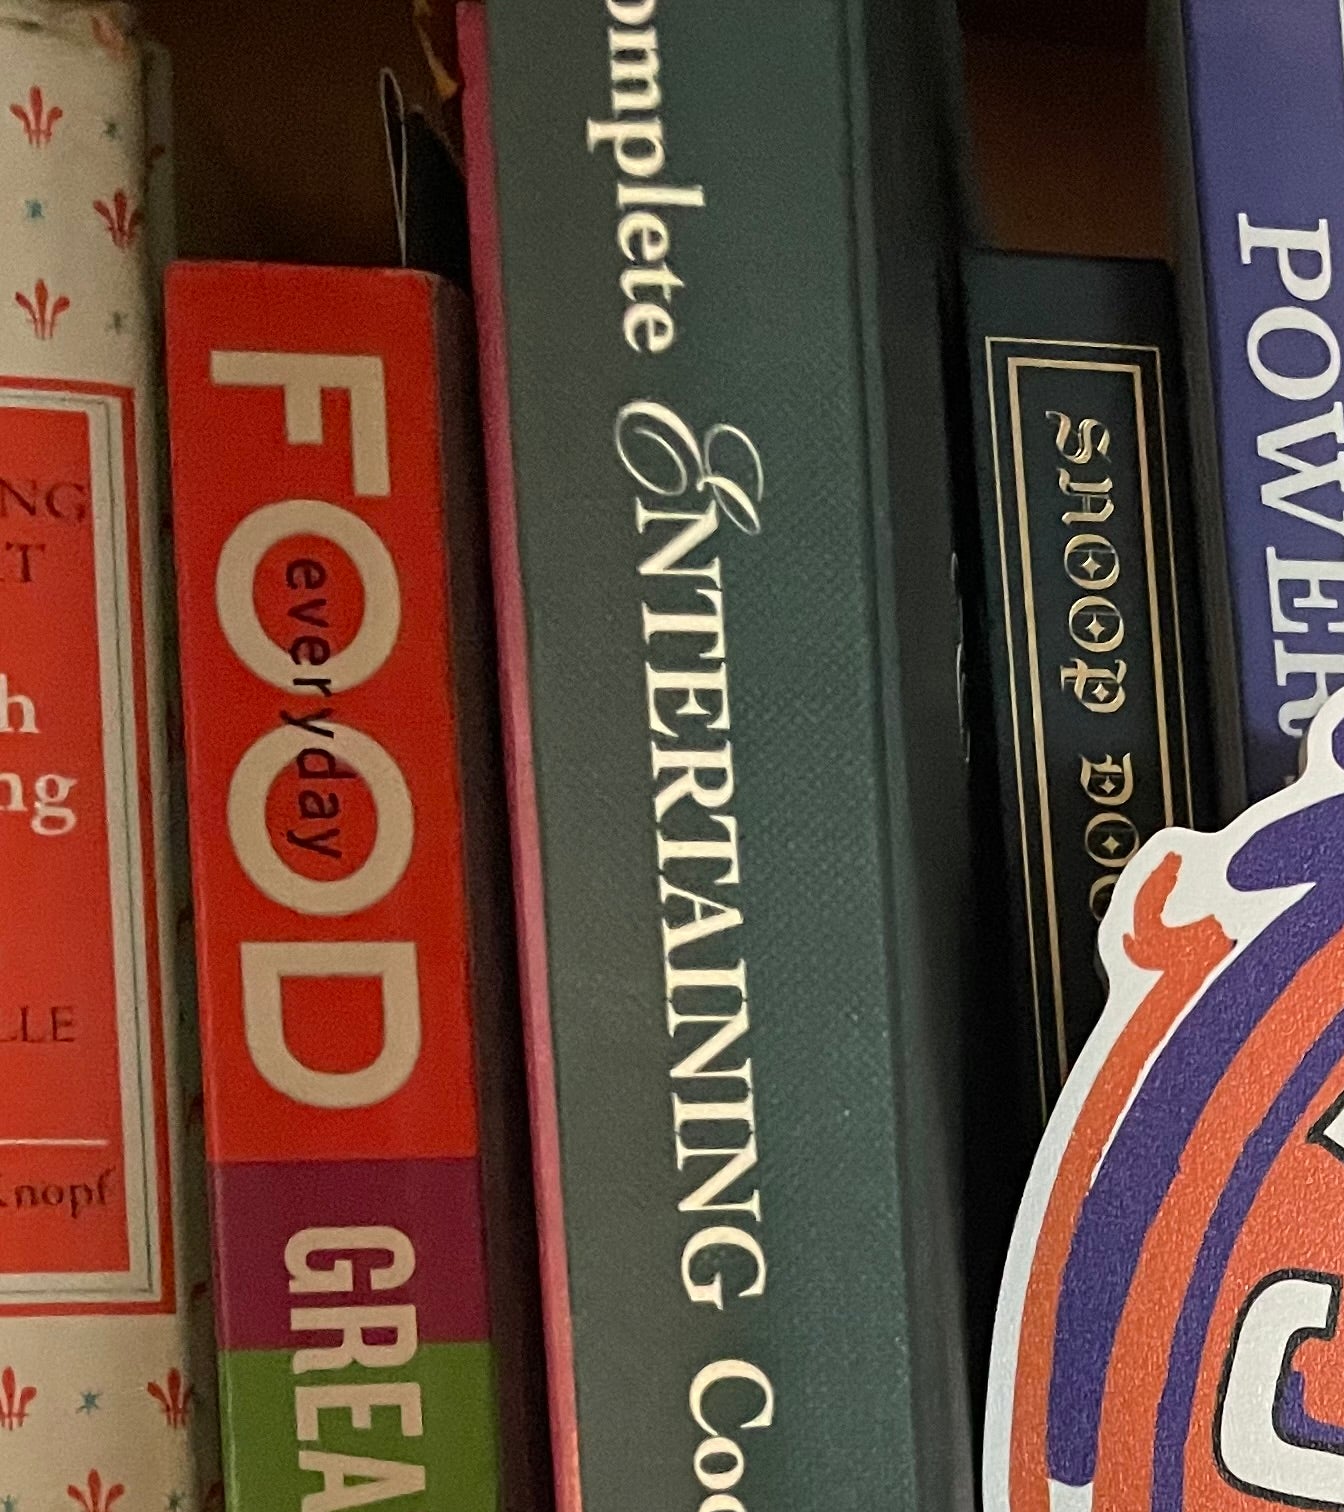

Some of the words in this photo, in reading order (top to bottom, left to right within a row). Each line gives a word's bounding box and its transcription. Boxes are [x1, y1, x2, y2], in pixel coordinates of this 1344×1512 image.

[280, 556, 358, 862] everyday
[1045, 410, 1127, 715] SNOOP
[209, 349, 424, 1110] FOOD
[613, 399, 768, 1311] ENTERTAINING
[0, 1166, 117, 1220] nopf
